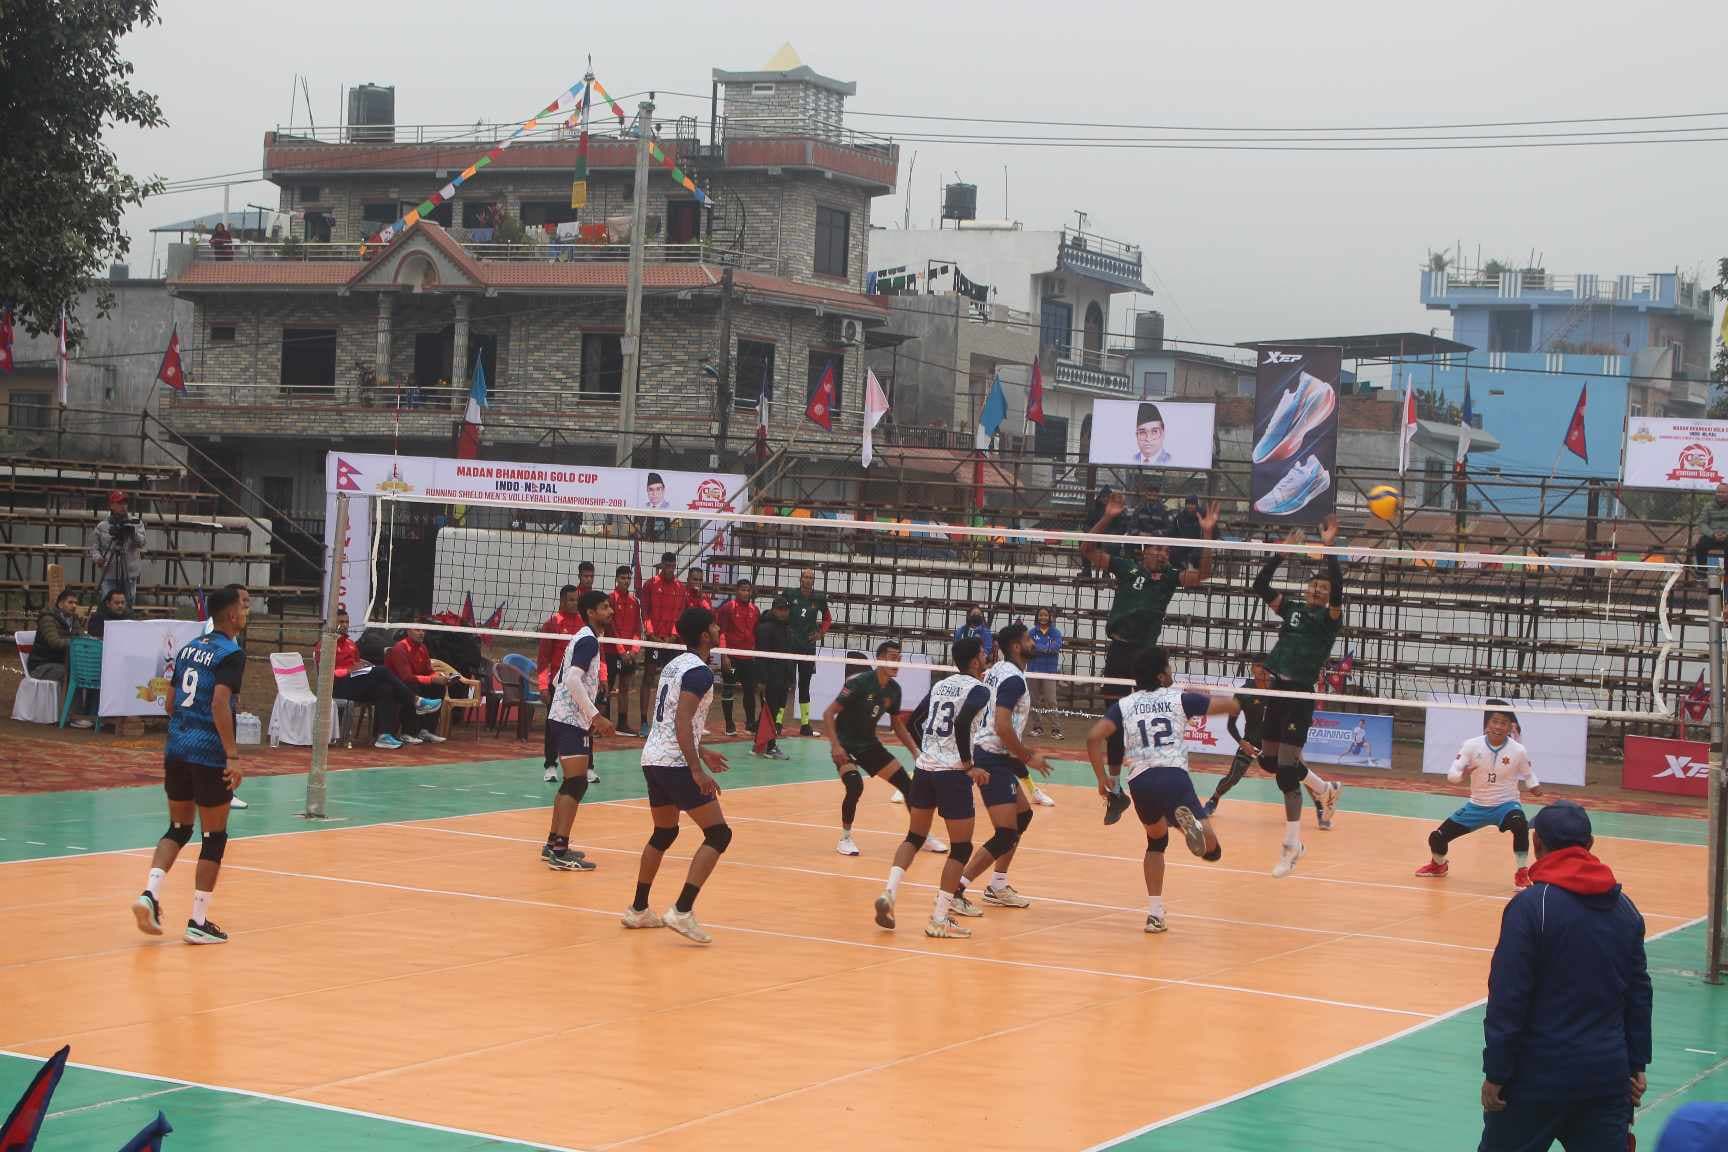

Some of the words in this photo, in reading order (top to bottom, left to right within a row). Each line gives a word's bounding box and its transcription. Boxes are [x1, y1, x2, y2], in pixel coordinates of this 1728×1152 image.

[456, 466, 494, 479] MADAN
[495, 468, 548, 481] BHANDARI
[550, 471, 576, 483] GOLD
[578, 473, 598, 485] CUP
[425, 488, 457, 498] RUNNING
[458, 489, 484, 500] SHIELD
[484, 491, 507, 502] MEN'S
[508, 493, 552, 504] VOLLEYBALL
[1132, 575, 1146, 591] 8
[800, 608, 807, 618] 2
[1289, 611, 1300, 627] 6
[181, 667, 198, 707] 9
[924, 700, 955, 738] 13
[1137, 717, 1175, 748] 12
[1308, 727, 1352, 741] RAINING
[1487, 771, 1497, 784] 13
